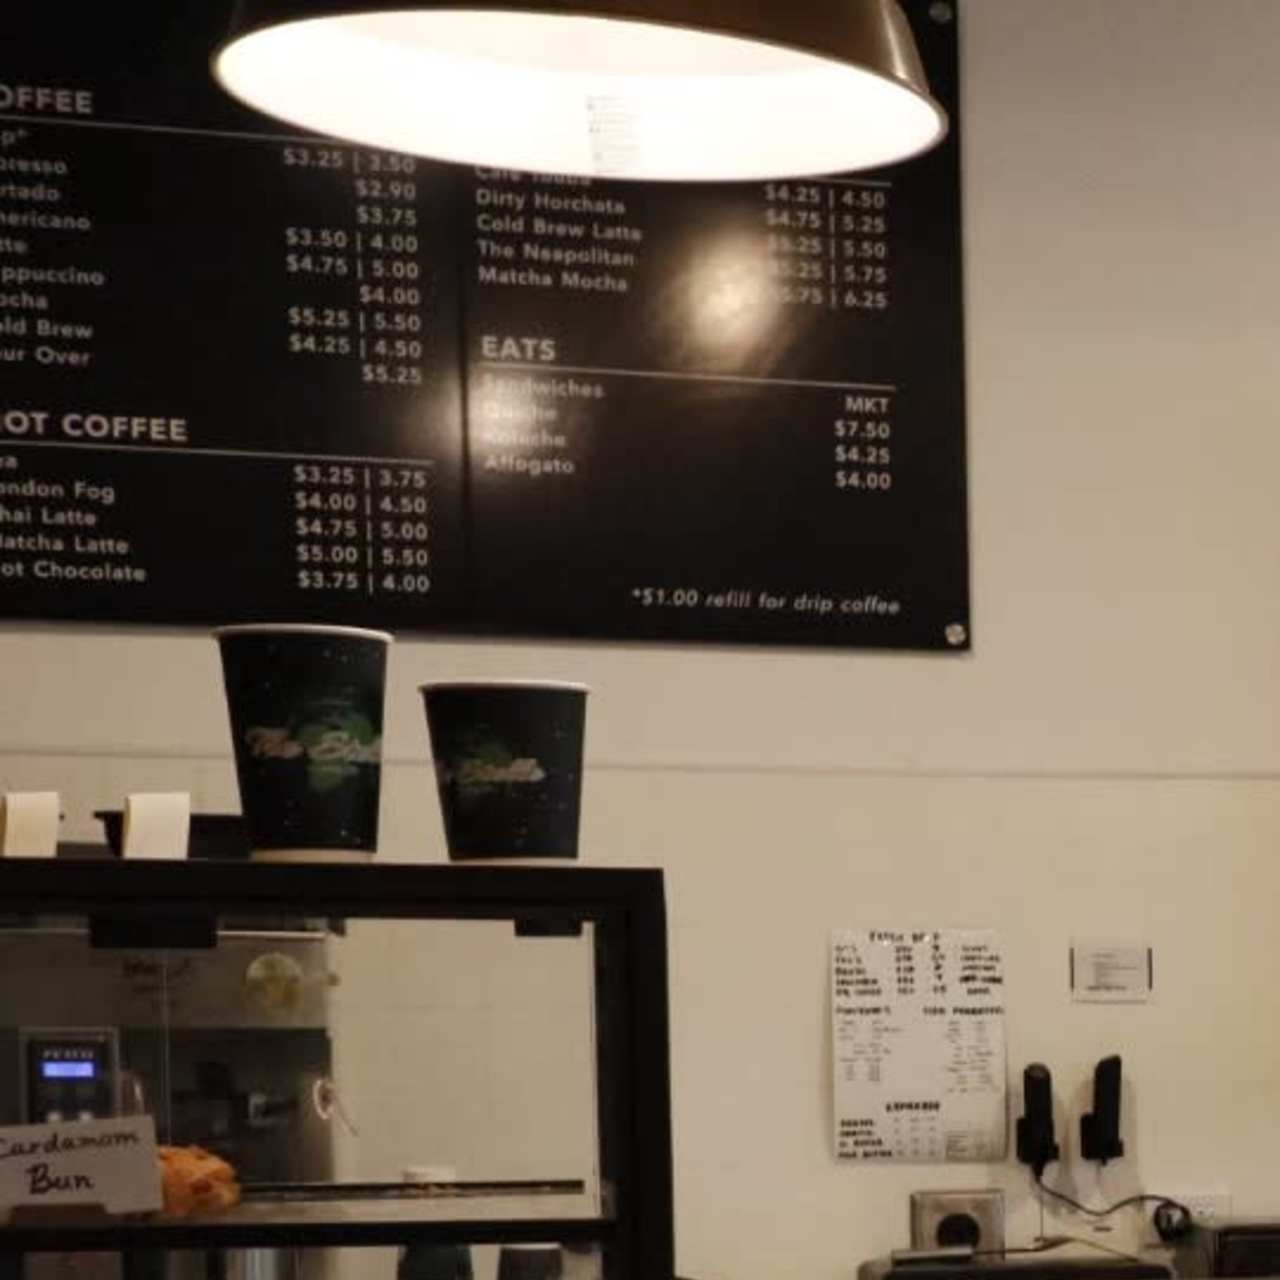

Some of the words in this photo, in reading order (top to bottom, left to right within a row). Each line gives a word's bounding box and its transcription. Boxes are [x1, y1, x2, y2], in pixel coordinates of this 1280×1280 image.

[283, 147, 344, 169] $3.25
[369, 153, 416, 175] 3.50
[355, 179, 417, 200] $2.90
[475, 187, 526, 211] Dirty
[534, 192, 626, 214] Horchata
[764, 183, 821, 204] $4.25
[841, 189, 886, 209] 4.50
[356, 206, 418, 227] $3.75
[476, 213, 525, 233] Cold
[533, 217, 586, 238] Brew
[592, 222, 643, 242] Latte
[765, 208, 821, 229] $4.75
[842, 214, 886, 234] 5.25
[285, 226, 348, 248] $3.50
[370, 233, 419, 253] 4.00
[842, 239, 887, 259] 5.50
[477, 238, 515, 258] The
[523, 242, 635, 267] Neapolitan
[286, 253, 349, 275] $4.75
[371, 259, 420, 279] 5.00
[843, 264, 888, 284] 5.75
[477, 265, 553, 287] Matcha
[560, 271, 629, 292] Mocha
[359, 284, 421, 306] $4.00
[843, 289, 889, 310] 6.25
[36, 318, 95, 340] Brew
[288, 306, 351, 328] $5.25
[373, 311, 421, 332] 5.50
[35, 347, 92, 367] Over
[288, 333, 351, 354] $4.25
[374, 338, 422, 359] 4.50
[480, 335, 557, 362] EATS
[362, 364, 423, 385] $5.25
[845, 395, 891, 415] MKT
[61, 412, 190, 442] COFFEE
[834, 419, 893, 440] $7.50
[484, 455, 576, 477] Affogato
[834, 444, 893, 465] $4.25
[293, 463, 355, 485] $3.25
[379, 468, 427, 489] 3.75
[835, 470, 893, 491] $4.00
[74, 481, 116, 505] Fog
[294, 490, 357, 511] $4.00
[379, 495, 428, 514] 4.50
[42, 506, 98, 526] Latte
[295, 516, 358, 538] $4.75
[380, 520, 429, 541] 5.00
[0, 532, 65, 552] atcha
[74, 535, 130, 555] Latte
[296, 543, 359, 563] $5.00
[381, 547, 429, 567] 5.50
[33, 559, 148, 582] Chocolate
[297, 568, 360, 590] $3.75
[382, 572, 430, 592] 4.00
[703, 590, 753, 609] refill
[757, 591, 788, 609] for
[792, 593, 834, 616] drip
[838, 595, 902, 615] coffee
[26, 1161, 95, 1195] Bun
